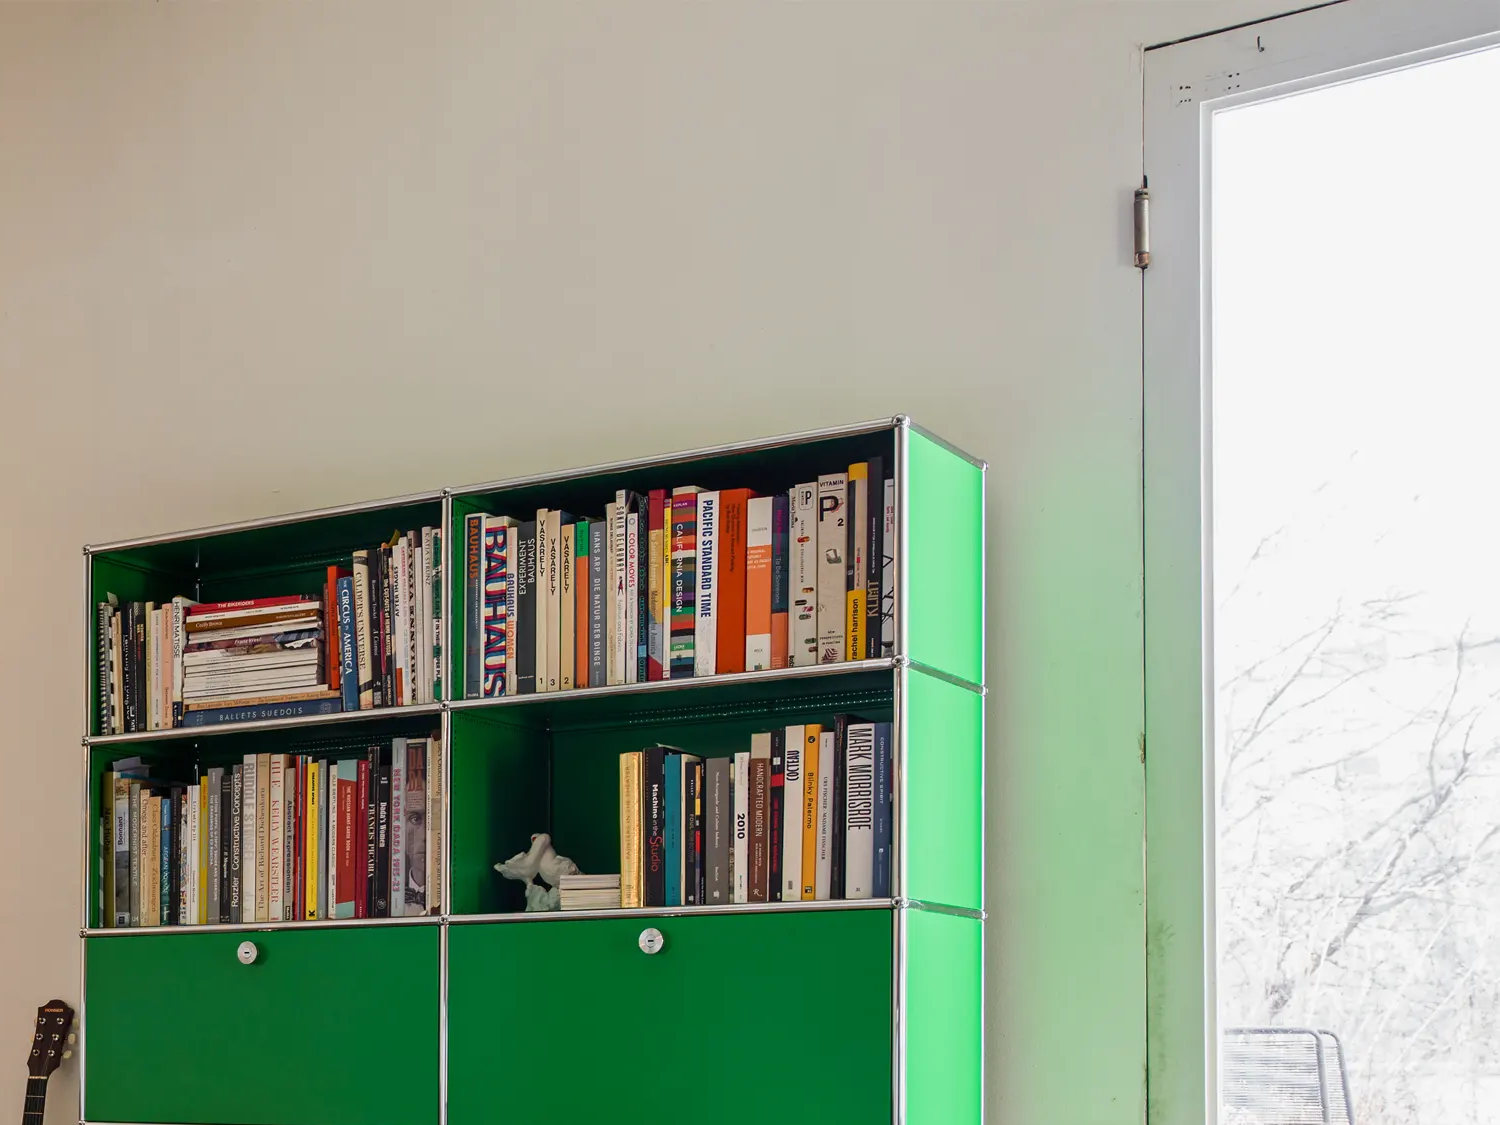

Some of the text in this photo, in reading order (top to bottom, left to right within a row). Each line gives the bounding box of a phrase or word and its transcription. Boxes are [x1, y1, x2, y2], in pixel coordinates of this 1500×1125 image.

[819, 480, 844, 488] VITAMIN
[819, 495, 839, 522] P
[469, 519, 479, 579] BAUHAUS
[527, 538, 535, 584] BAUHAUS
[616, 506, 625, 572] SONIA DELAUNAY
[700, 500, 714, 618] PACIFIC STANDARD TIME
[518, 540, 526, 595] EXPERIMENT
[227, 600, 254, 608] BIKERIDERS
[484, 526, 507, 697] BAUHAUS
[507, 573, 515, 618] BAUHAUS
[867, 580, 879, 616] KLIMT
[341, 589, 353, 675] CIRCUS AMERICA
[355, 572, 366, 670] CALDER'S UNIVERSE
[409, 605, 417, 702] MARIANNE
[219, 707, 303, 721] BALLETS SUEDOIS
[244, 763, 254, 811] RUDOLF
[756, 763, 764, 809] HANDCRAFTED
[787, 751, 800, 781] COCTEAU
[807, 772, 815, 795] Blinky
[848, 728, 872, 831] MARK MORRISROE
[393, 795, 401, 820] YORK
[737, 813, 746, 839] 2010
[756, 810, 764, 837] MODERN
[231, 773, 241, 907] Rotzler Constructive Concepts
[271, 761, 280, 903] HUE KELLY WEARSTLER
[379, 824, 387, 848] Women
[648, 836, 662, 872] Studio
[392, 858, 401, 892] 1915-23
